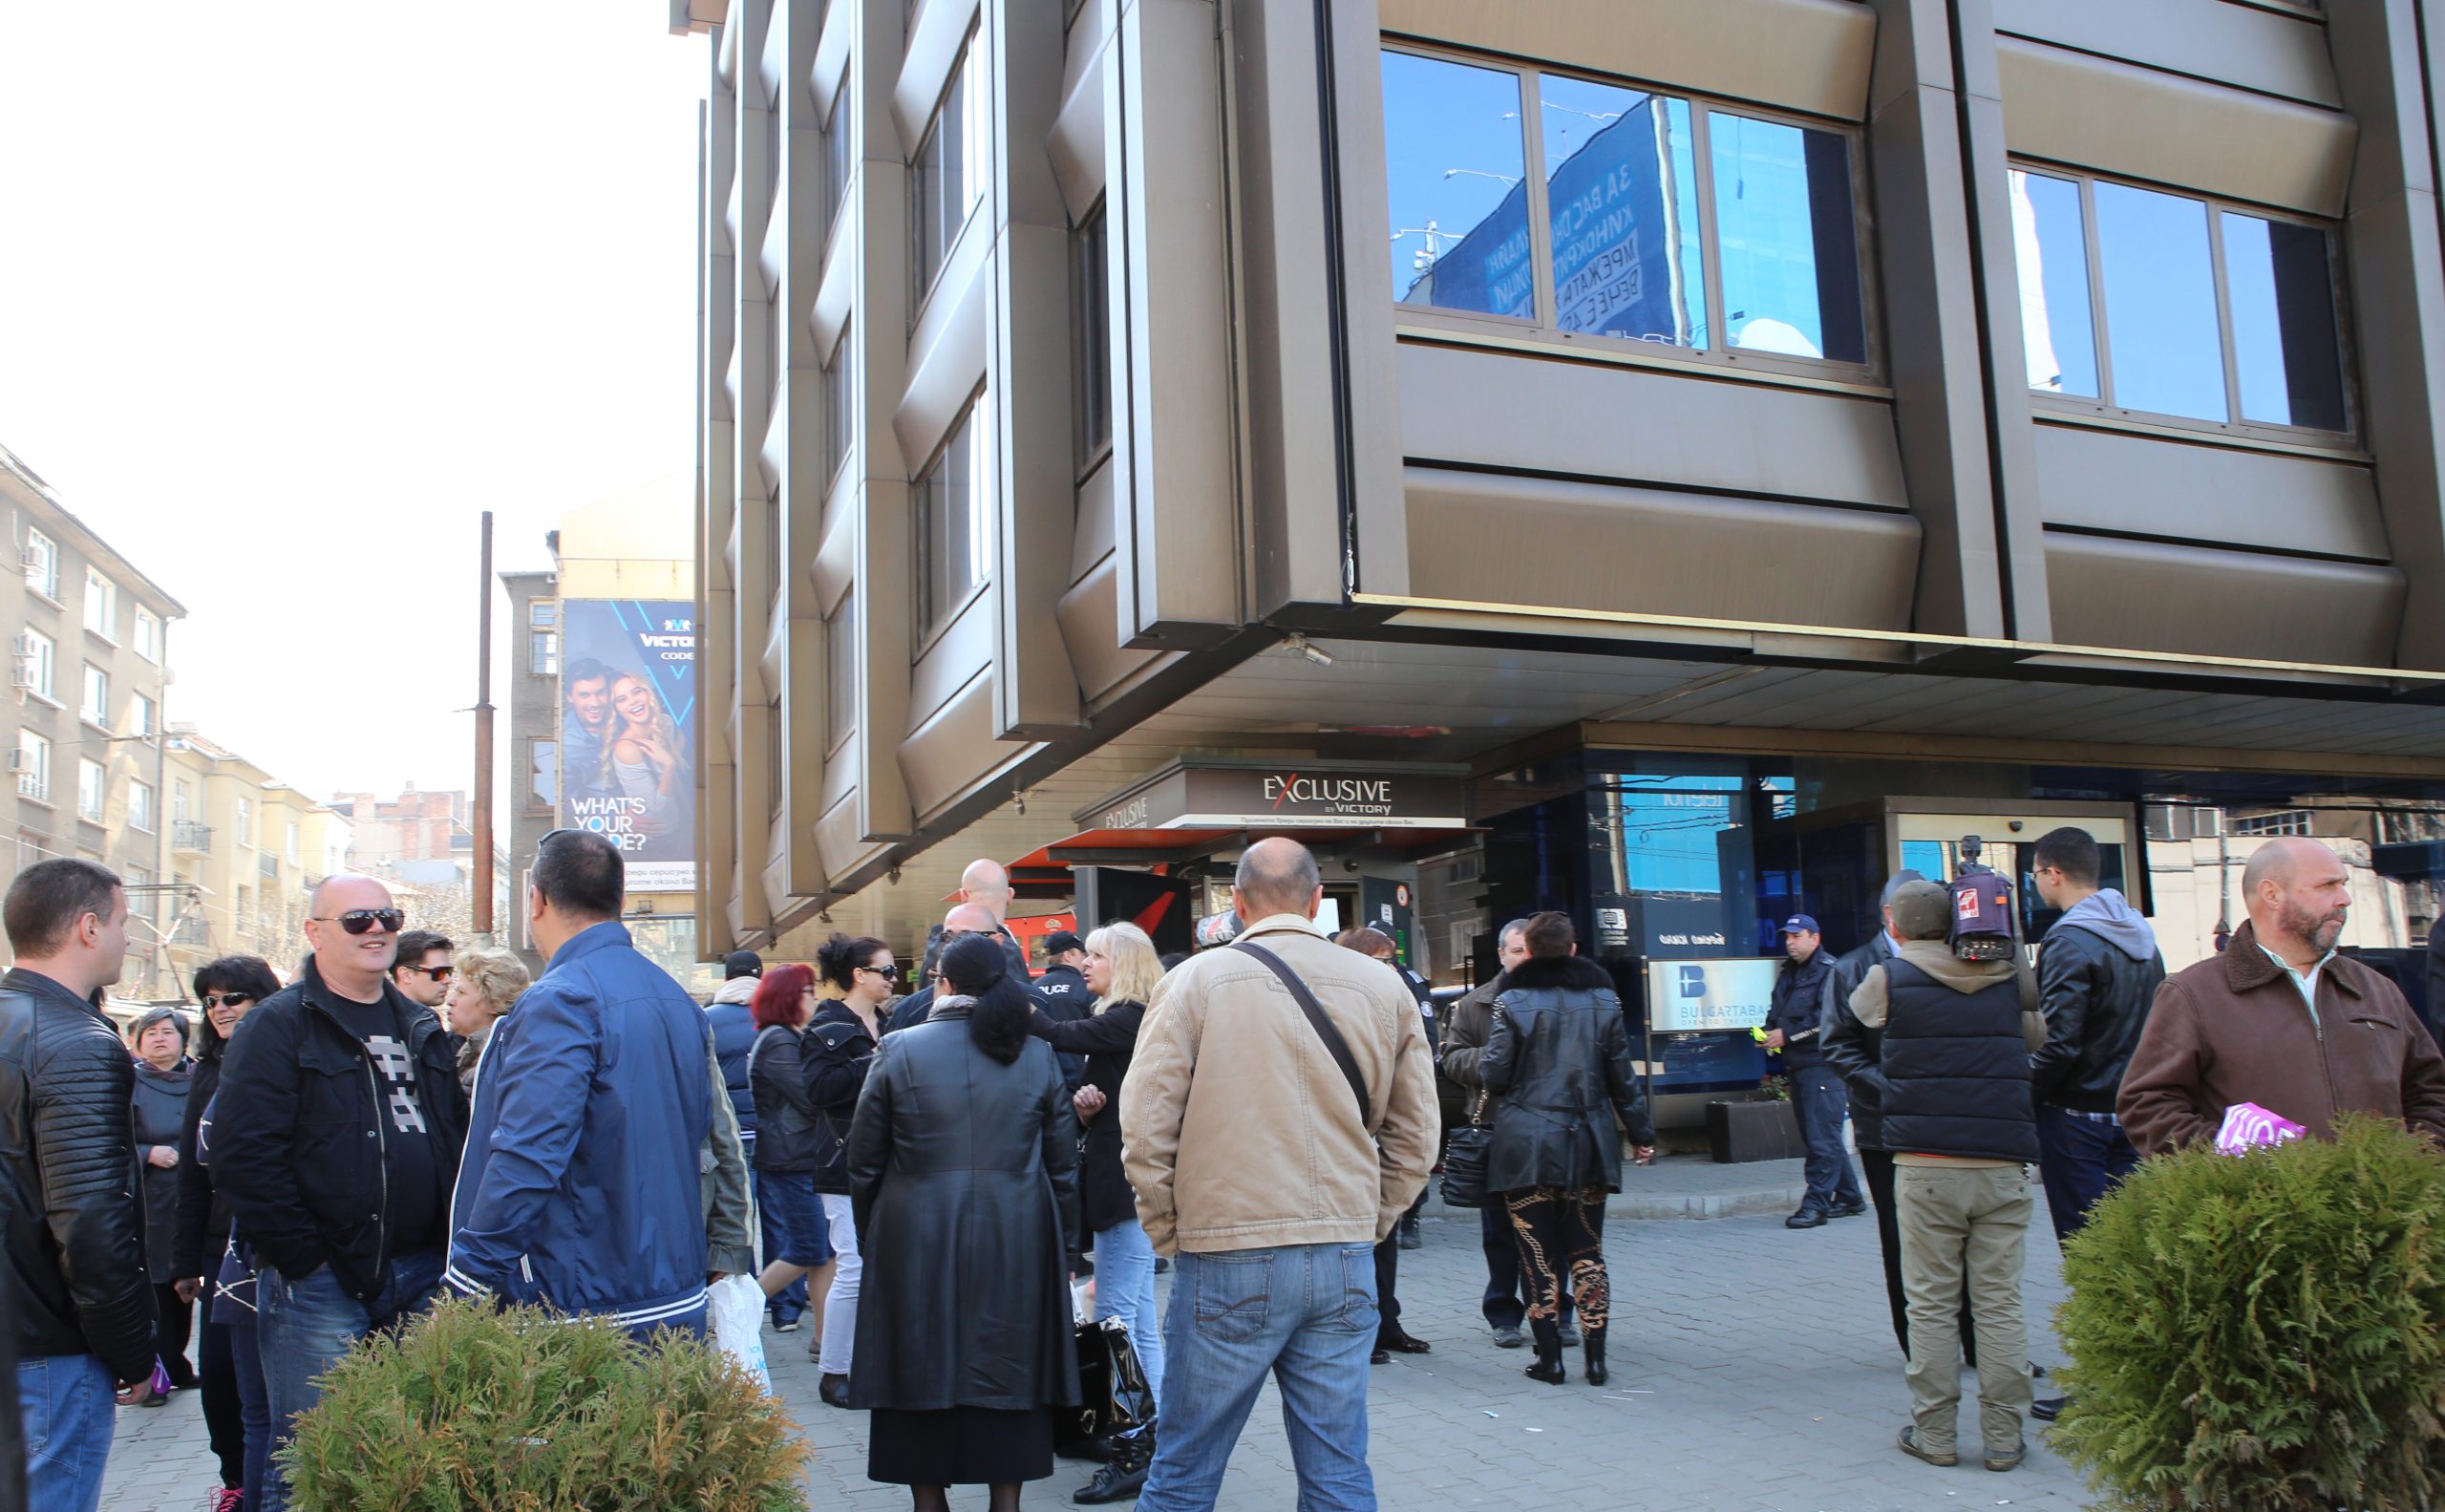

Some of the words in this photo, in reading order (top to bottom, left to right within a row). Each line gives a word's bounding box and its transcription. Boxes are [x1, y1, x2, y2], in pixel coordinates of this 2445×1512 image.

[660, 651, 695, 660] CODE
[1264, 773, 1392, 810] EXCLUSIVE
[570, 797, 647, 815] WHAT'S
[1335, 802, 1392, 816] VICTORY
[573, 816, 632, 833] YOUR
